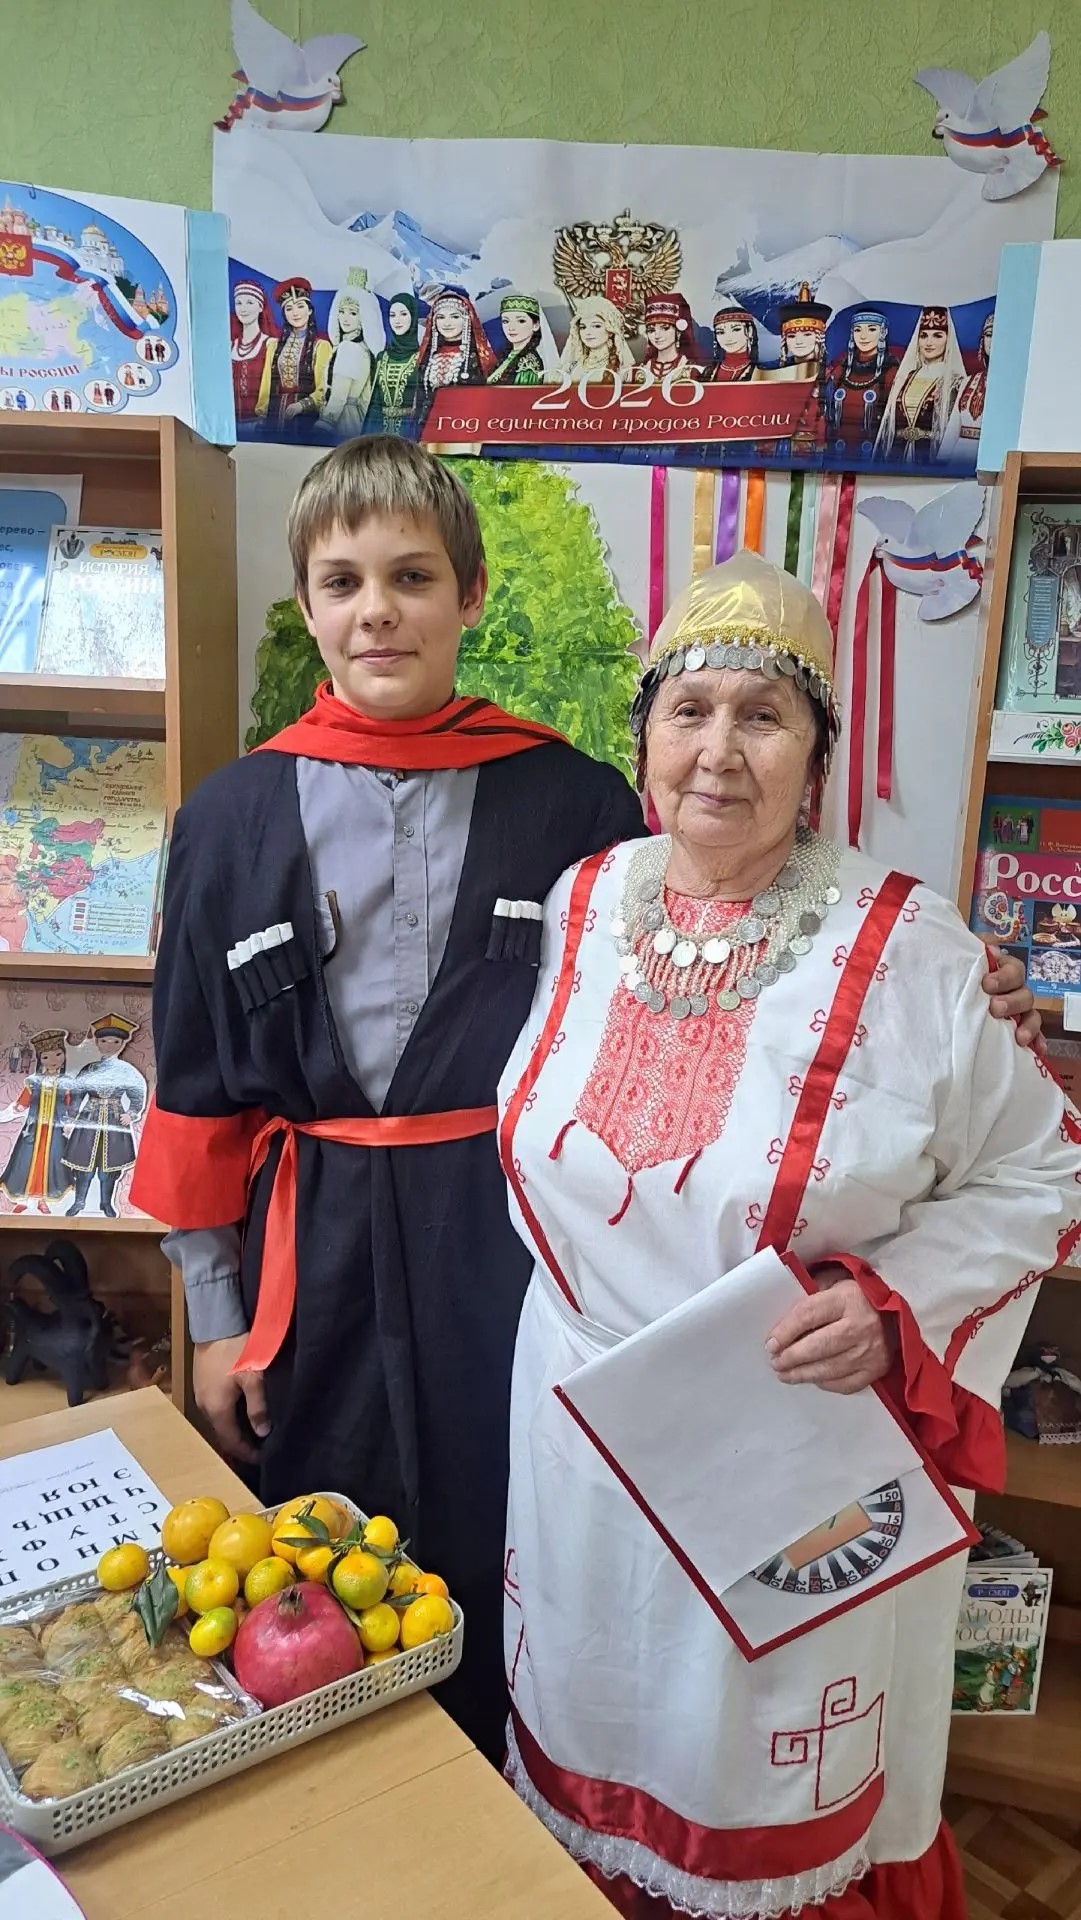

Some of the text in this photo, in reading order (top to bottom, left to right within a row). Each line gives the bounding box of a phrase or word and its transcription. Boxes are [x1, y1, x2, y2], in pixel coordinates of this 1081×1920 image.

[19, 365, 80, 378] РОССИИ
[531, 365, 705, 410] 2026
[437, 416, 480, 433] Год
[487, 417, 603, 432] единства
[707, 413, 791, 429] России
[80, 561, 150, 575] ИСТОРИЯ
[40, 1467, 132, 1503] Э Ю Я
[880, 1490, 899, 1503] 150
[12, 1486, 146, 1531] Ч Ш Щ Ъ
[22, 1501, 158, 1551] С Т У Ф
[887, 1514, 900, 1524] 15
[879, 1525, 899, 1535] 100
[878, 1536, 893, 1547] 30
[75, 1543, 103, 1559] Н
[37, 1557, 60, 1571] О
[864, 1554, 880, 1567] 25
[844, 1569, 858, 1583] 50
[956, 1627, 1029, 1641] ОССИИ
